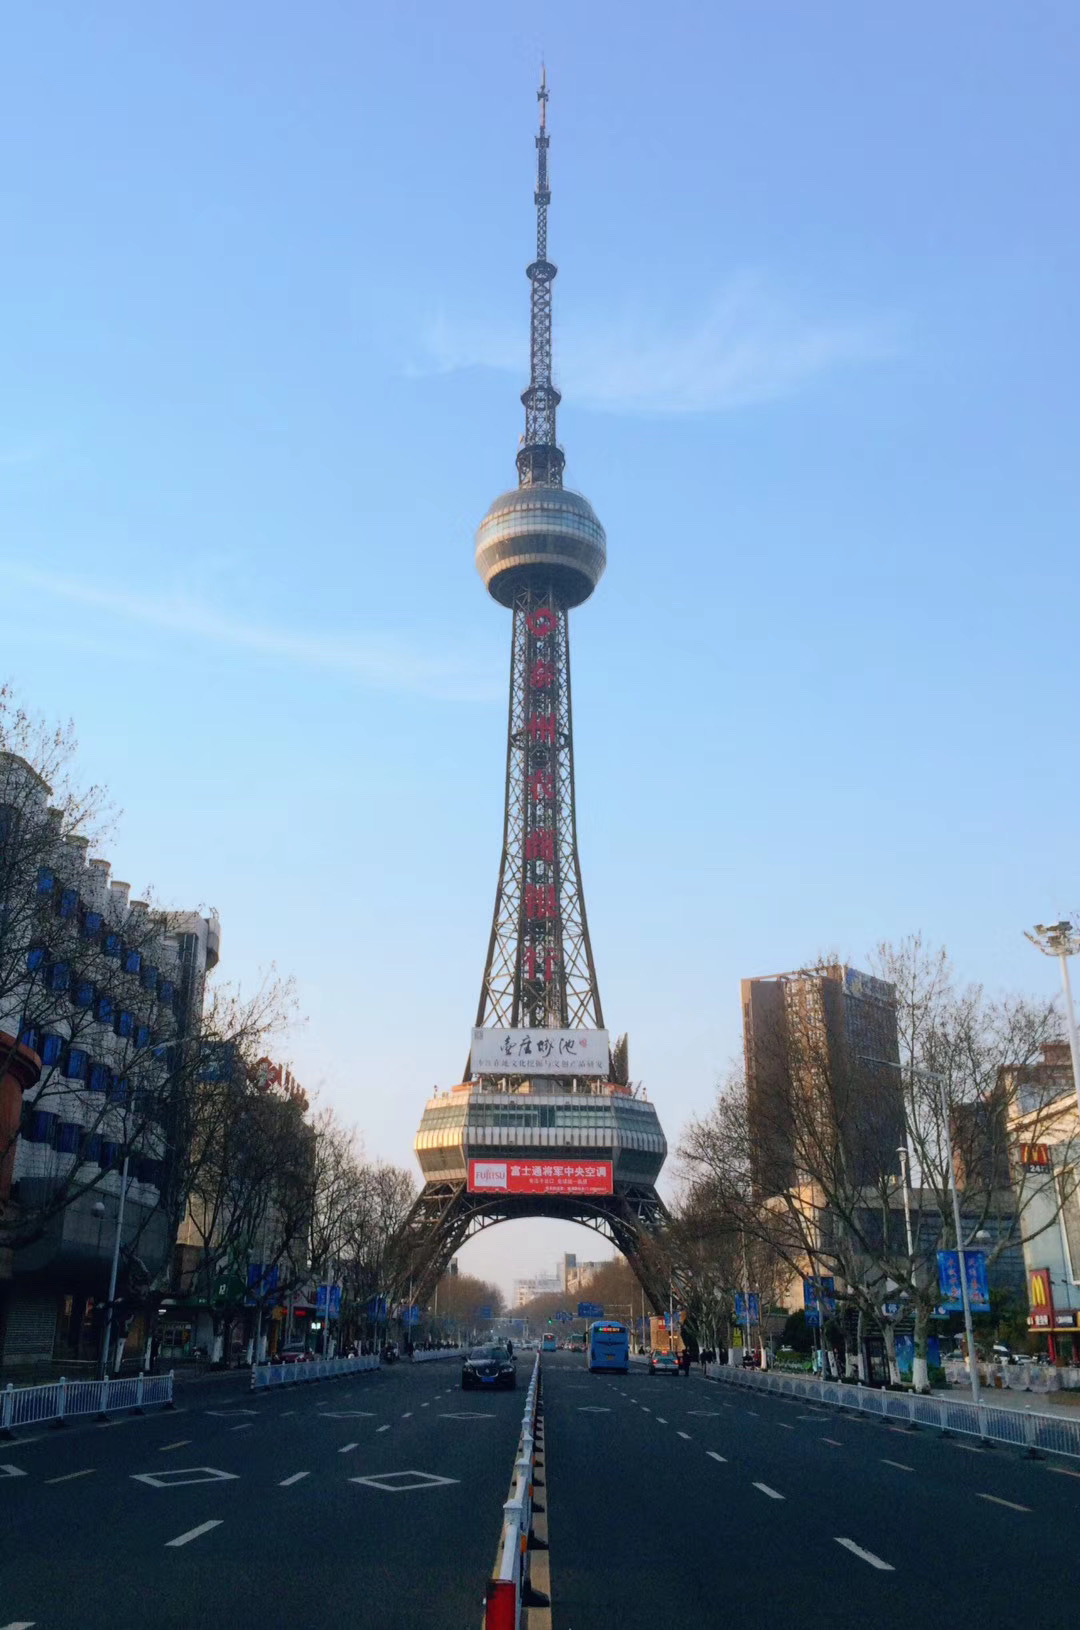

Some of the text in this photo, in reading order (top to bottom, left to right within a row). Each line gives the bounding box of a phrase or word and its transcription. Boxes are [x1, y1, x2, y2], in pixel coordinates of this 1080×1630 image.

[476, 1169, 505, 1181] FUJITSU
[510, 1165, 607, 1177] 富士通将军中央空调
